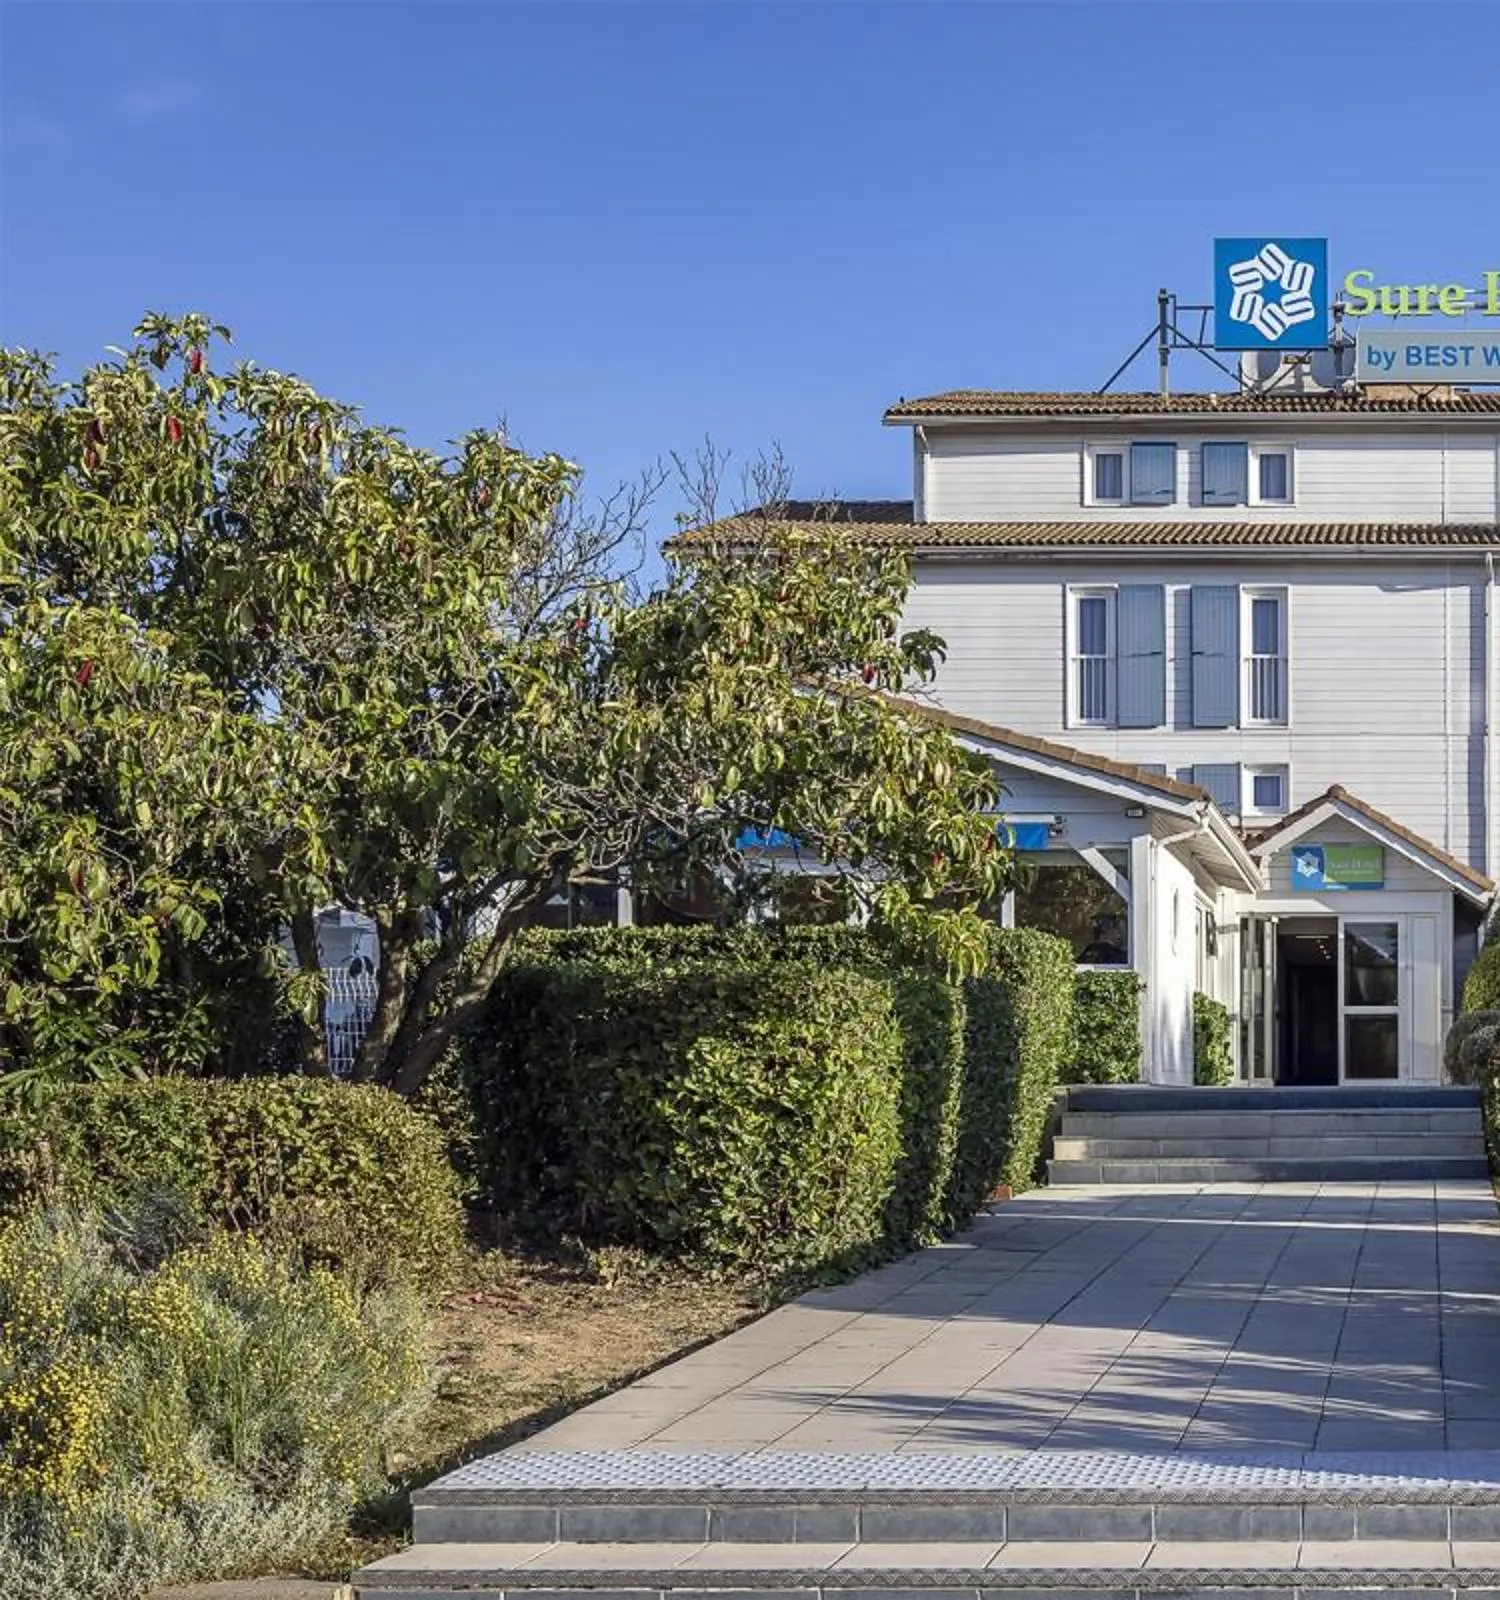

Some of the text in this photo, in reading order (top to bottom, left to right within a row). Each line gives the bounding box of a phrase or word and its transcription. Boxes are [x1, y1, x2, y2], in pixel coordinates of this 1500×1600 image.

[1343, 270, 1465, 317] Sure
[1367, 345, 1396, 370] by
[1405, 345, 1474, 367] BEST
